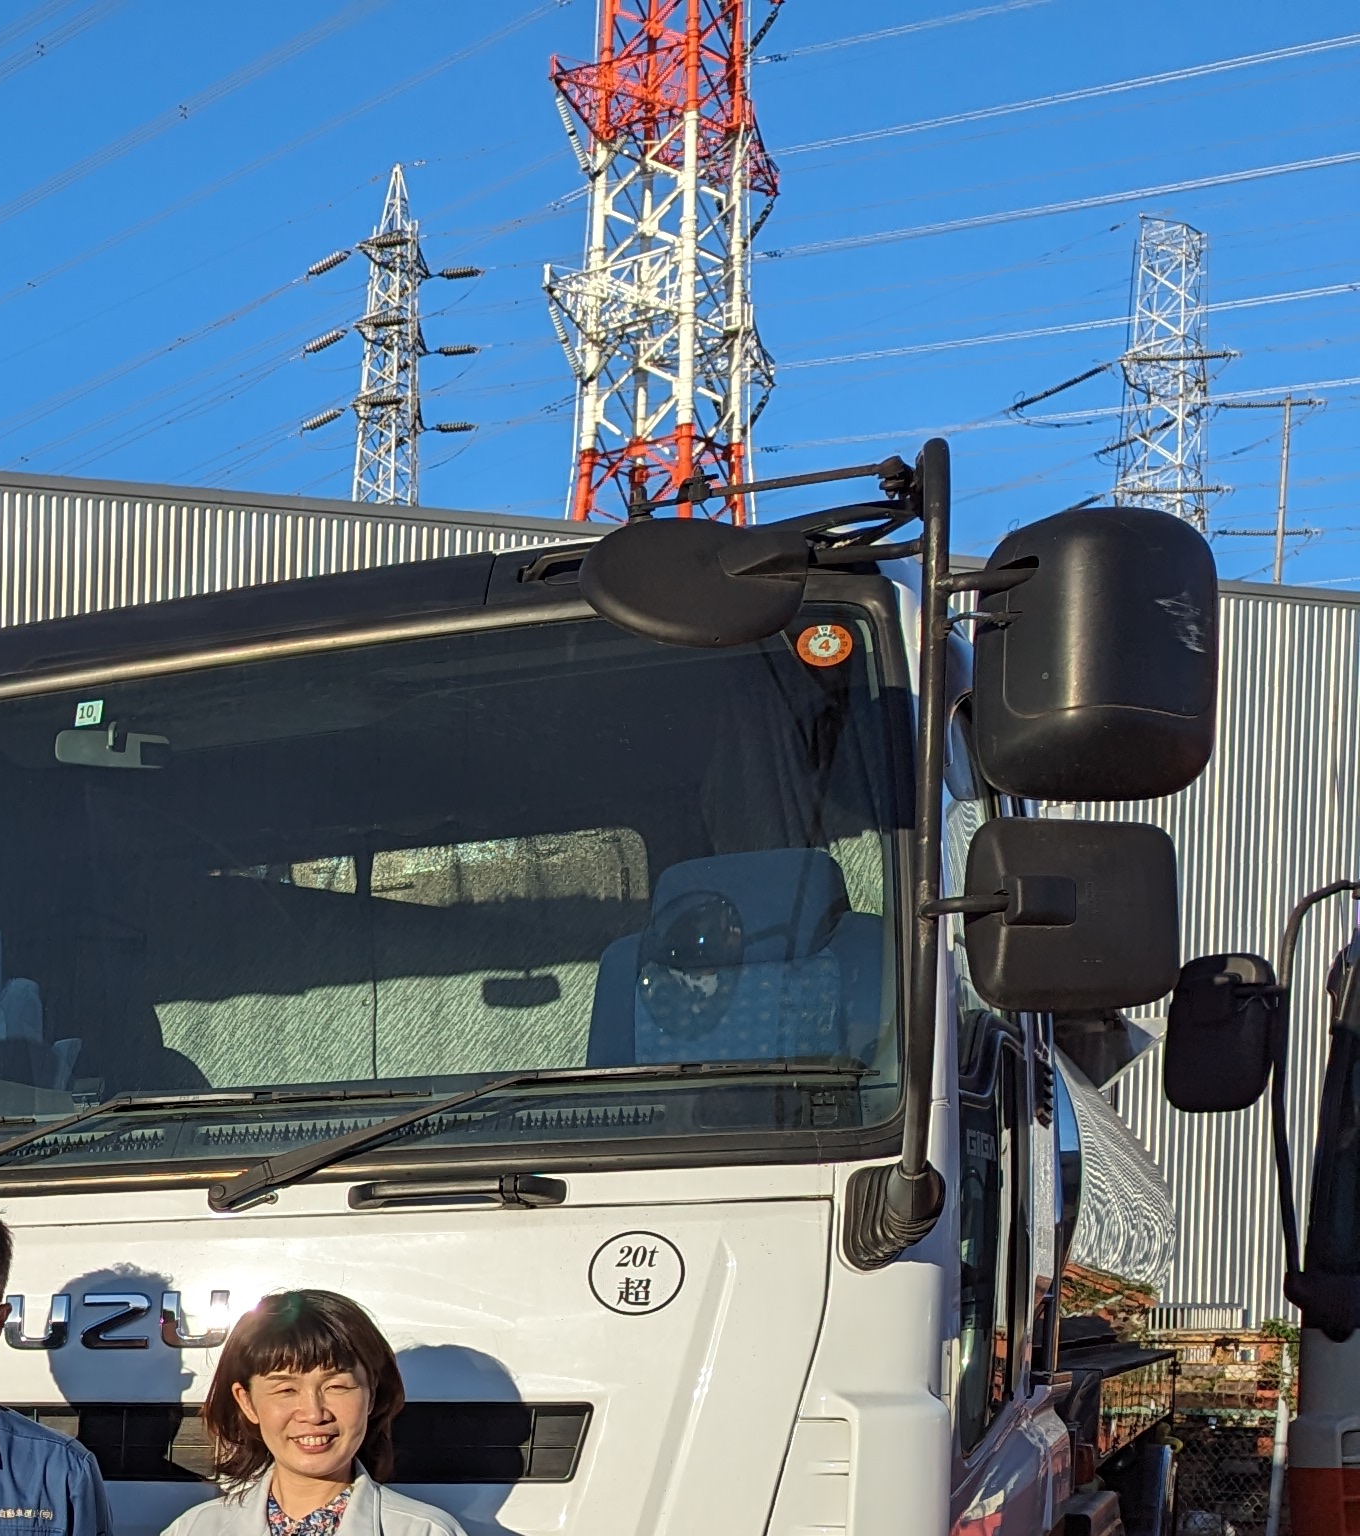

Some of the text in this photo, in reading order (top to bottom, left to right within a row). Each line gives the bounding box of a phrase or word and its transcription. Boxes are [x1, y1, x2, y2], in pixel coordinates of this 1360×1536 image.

[819, 639, 831, 652] 4
[79, 704, 94, 719] 10
[966, 1129, 996, 1161] GIGA
[615, 1246, 659, 1267] 20t
[616, 1277, 652, 1306] 超
